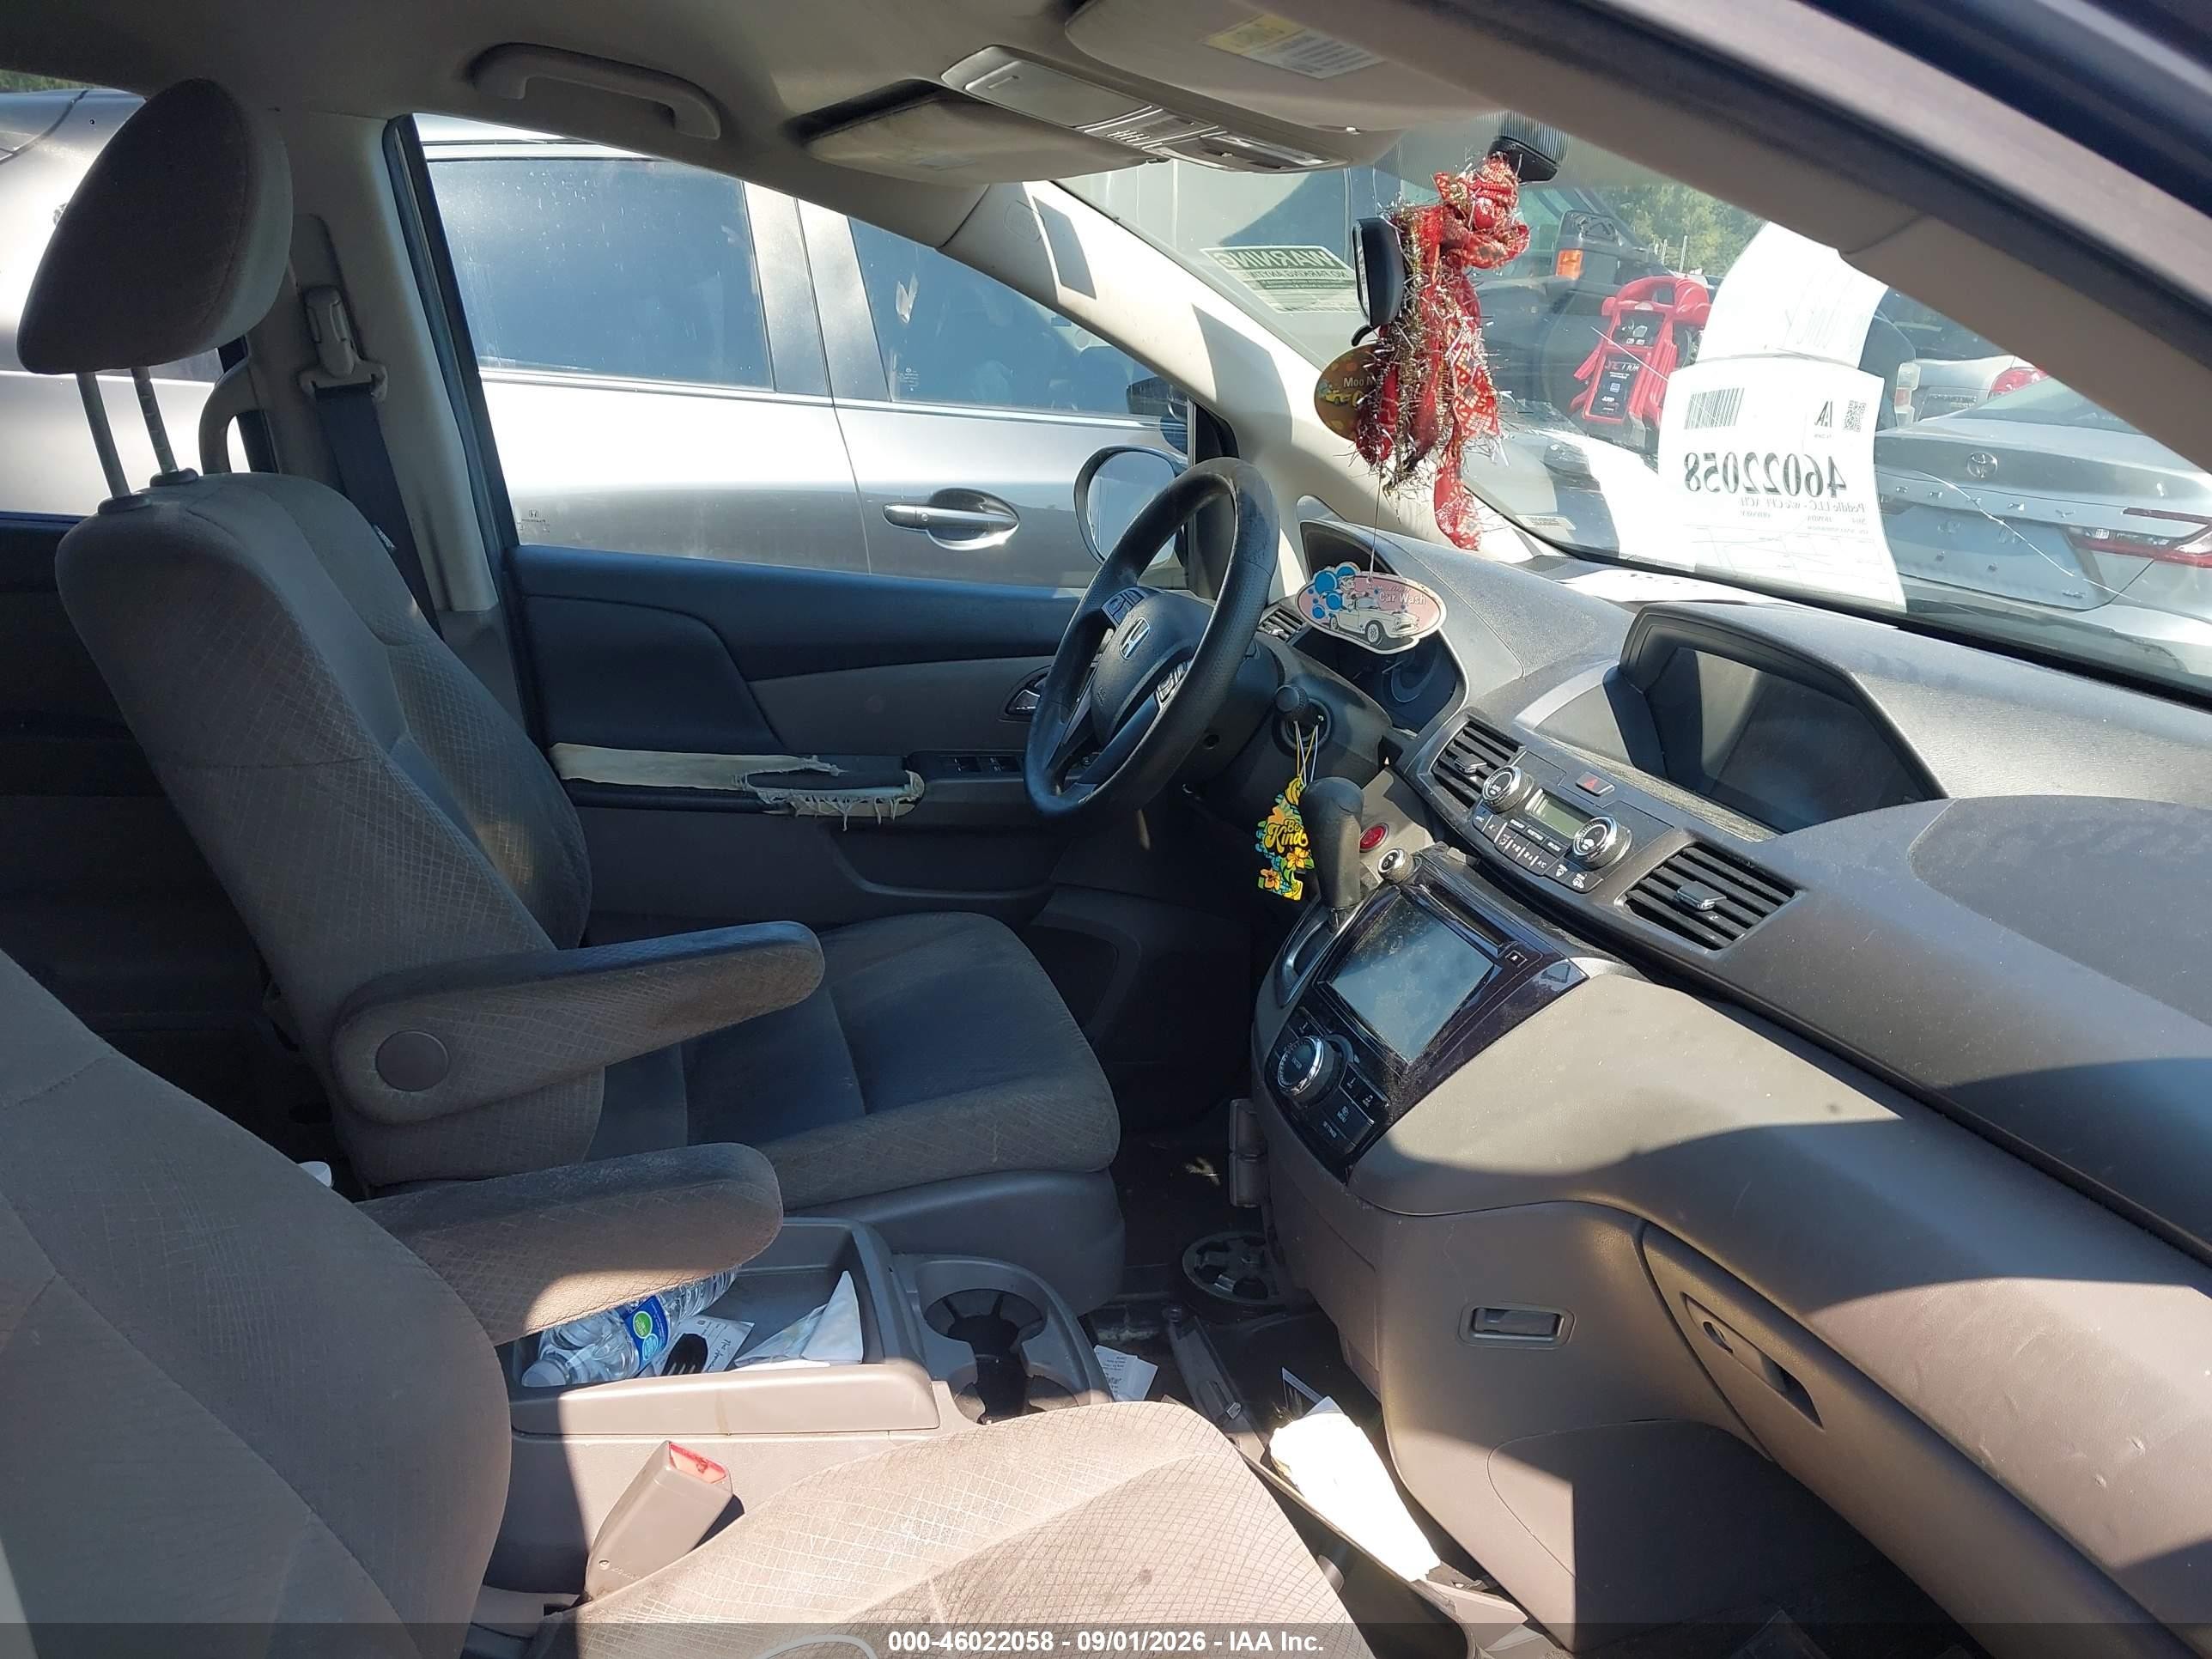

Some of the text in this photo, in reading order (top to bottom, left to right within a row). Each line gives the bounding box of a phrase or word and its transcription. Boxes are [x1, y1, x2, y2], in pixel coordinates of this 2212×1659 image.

[1343, 377, 1364, 388] Moo
[1379, 591, 1427, 605] Car Wash
[1285, 818, 1302, 832] Be
[1264, 823, 1309, 854] Kind
